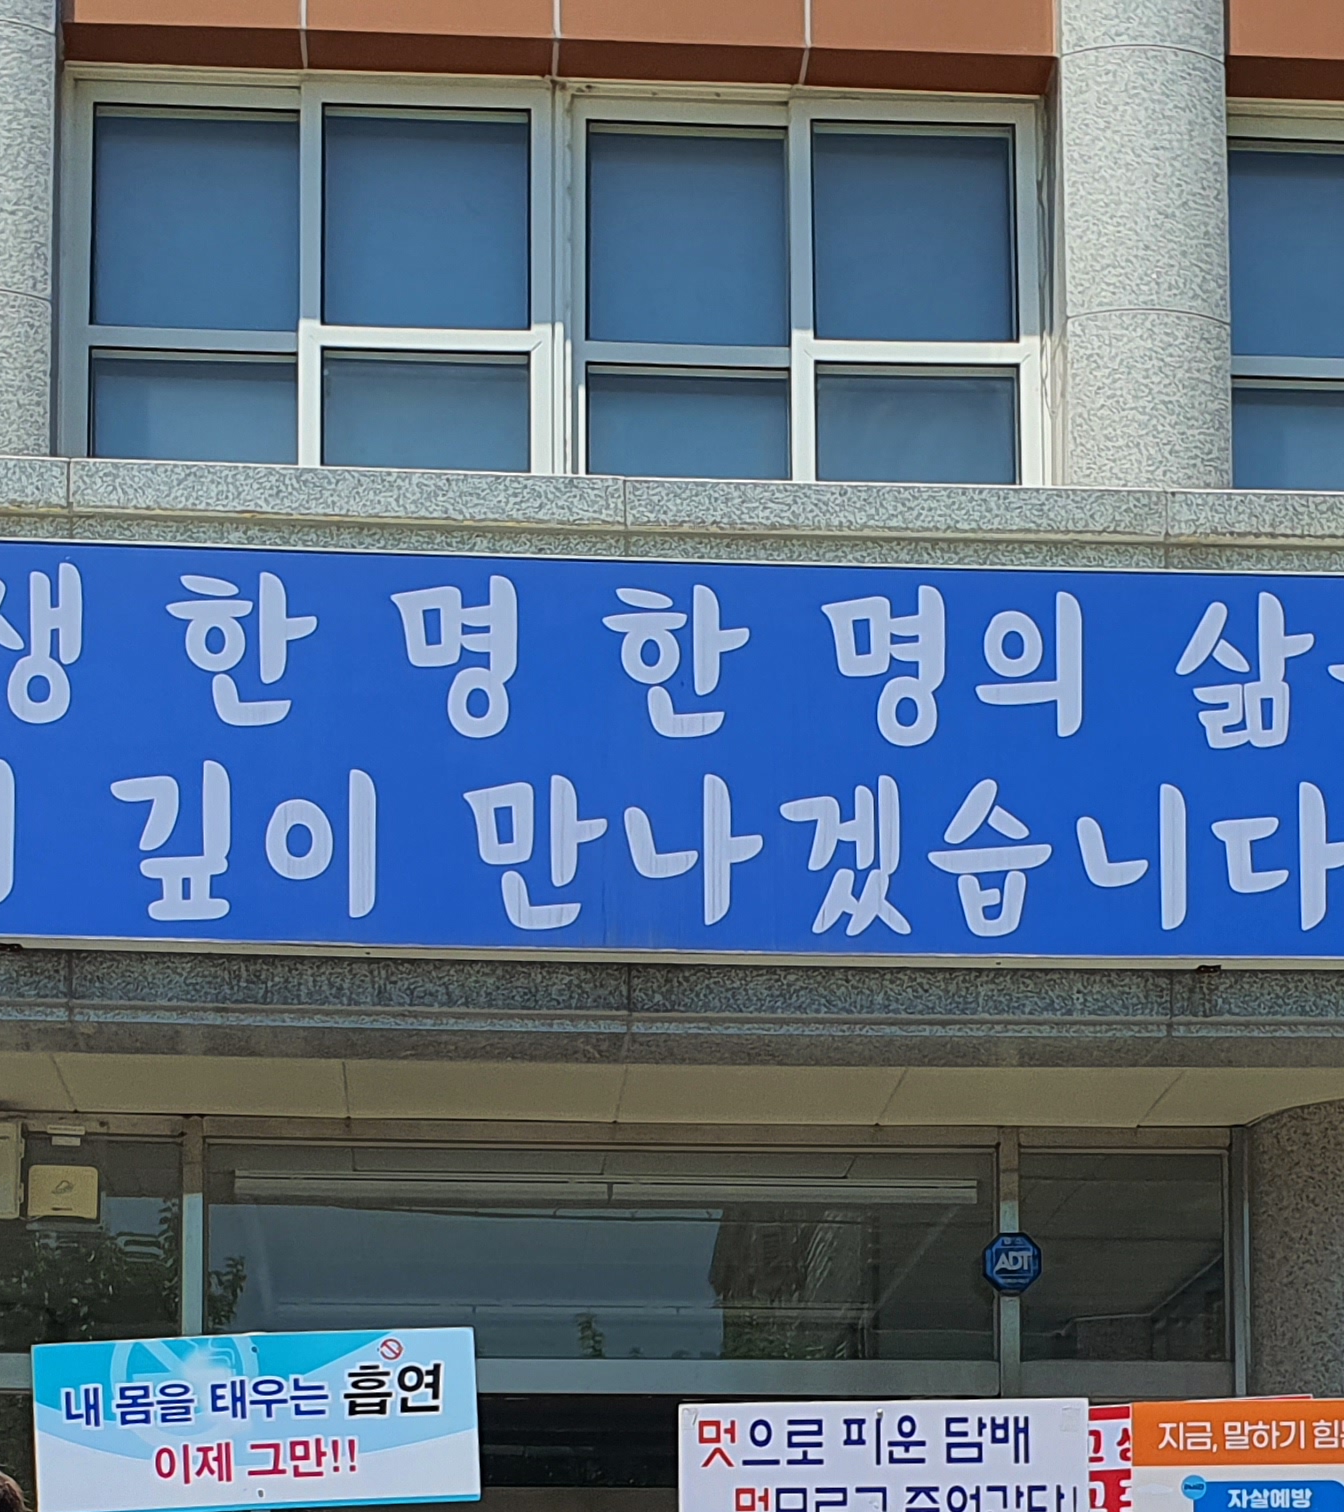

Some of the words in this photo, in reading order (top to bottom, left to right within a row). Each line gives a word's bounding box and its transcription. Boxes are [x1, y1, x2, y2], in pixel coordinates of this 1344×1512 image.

[166, 572, 318, 727] 한
[390, 575, 519, 738] 명
[602, 585, 749, 738] 한
[821, 585, 1083, 747] 명의
[110, 760, 377, 920] 깊이
[995, 1251, 1032, 1272] ADT
[64, 1387, 102, 1427] 내
[115, 1381, 195, 1425] 몸을
[211, 1377, 329, 1420] 태우는
[343, 1362, 442, 1417] 흡연
[155, 1441, 233, 1485] 이제
[247, 1437, 358, 1478] 그만!!
[697, 1417, 825, 1467] 멋으로
[842, 1415, 926, 1465] 피운
[945, 1415, 1030, 1464] 담배
[1158, 1421, 1217, 1453] 지금,
[1224, 1419, 1306, 1450] 말하기
[1227, 1488, 1312, 1509] 자살예방
